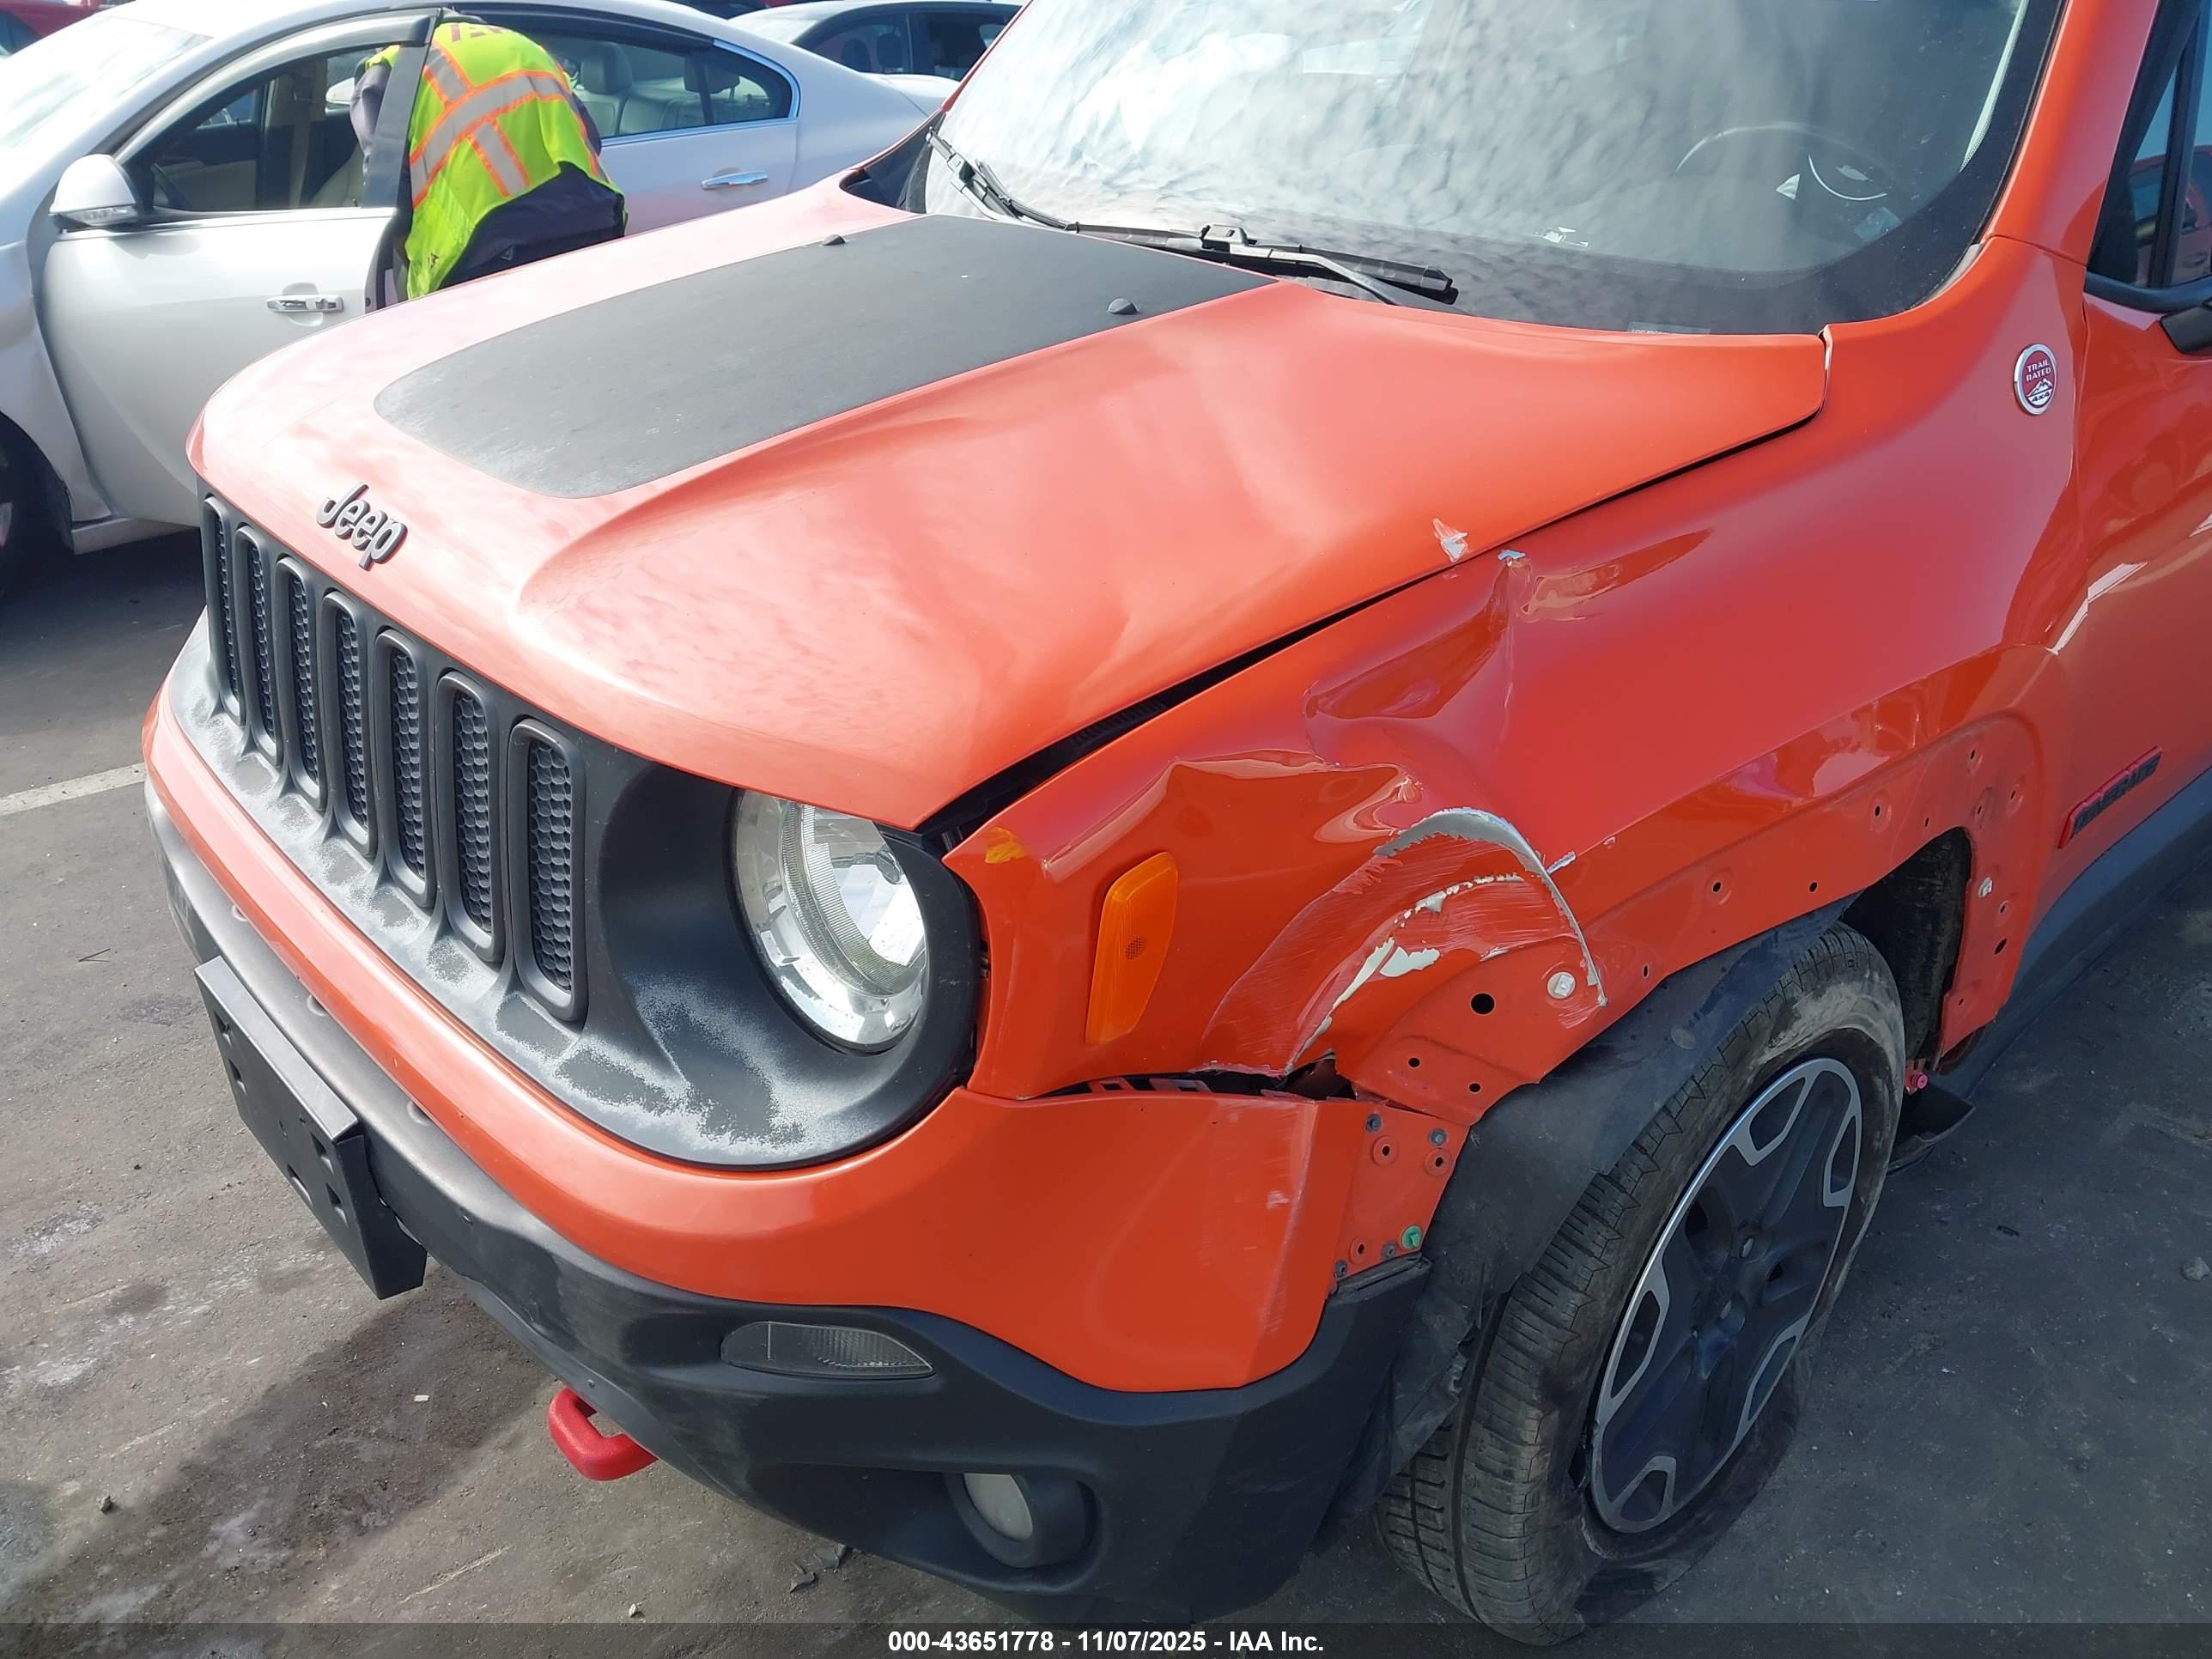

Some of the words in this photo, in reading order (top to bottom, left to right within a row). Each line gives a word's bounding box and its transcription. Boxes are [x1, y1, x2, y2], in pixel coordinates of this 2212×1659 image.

[2027, 359, 2050, 373] TRAIL
[2026, 367, 2051, 382] RATED
[316, 483, 409, 572] Jeep
